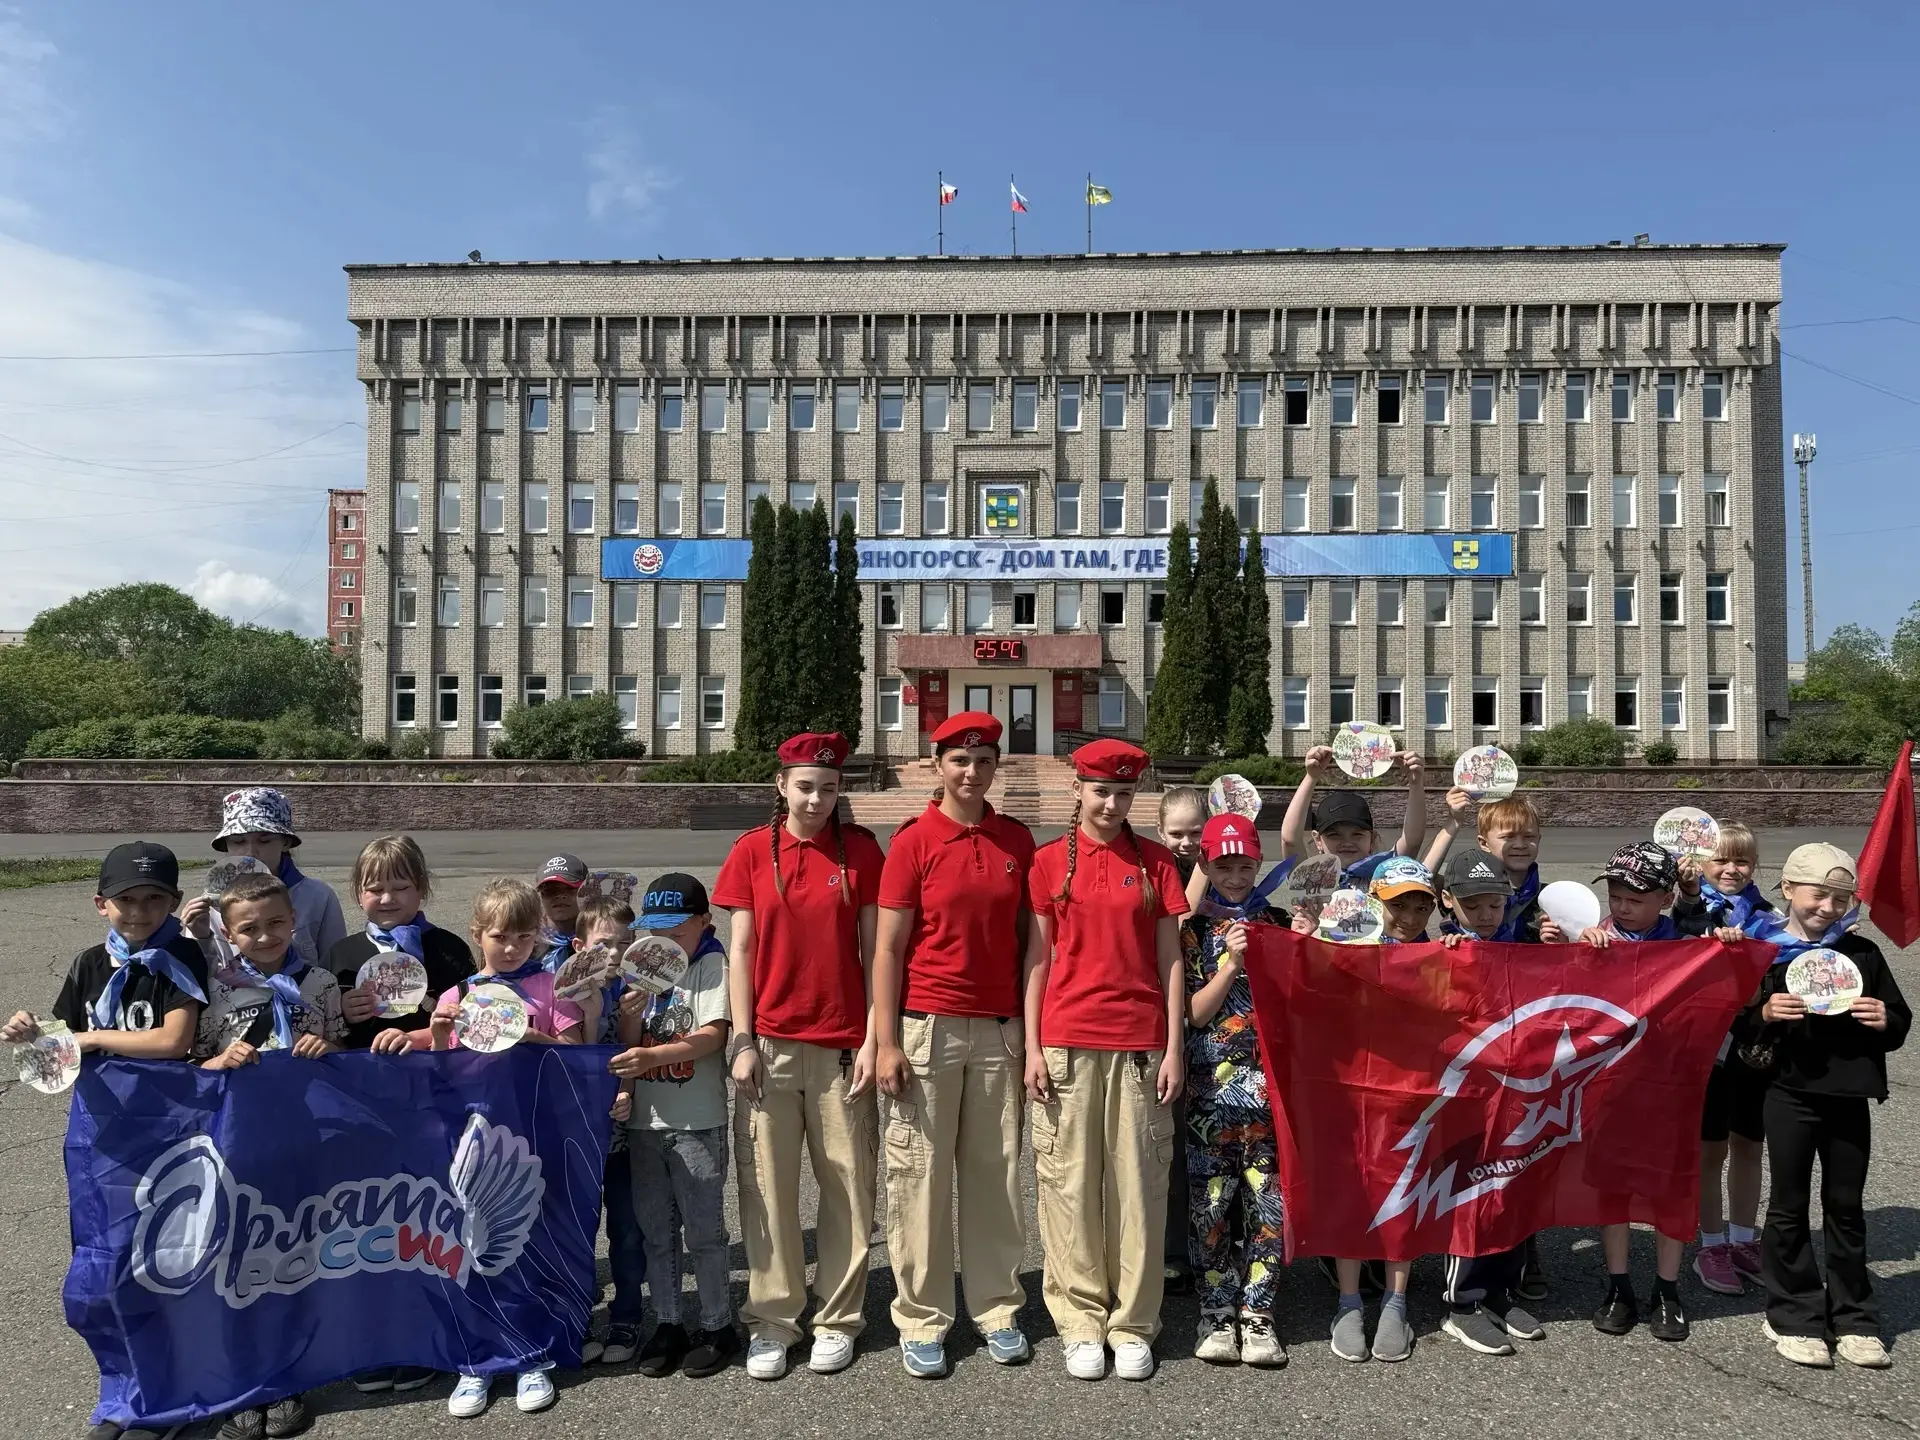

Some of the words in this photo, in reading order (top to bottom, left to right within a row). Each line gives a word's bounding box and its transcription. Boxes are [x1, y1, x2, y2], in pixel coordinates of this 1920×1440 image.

[861, 549, 981, 569] ЯНОГОРСК
[1000, 549, 1056, 573] ДОМ
[1061, 549, 1117, 571] ТАМ,
[1122, 549, 1167, 573] ГДЕ
[543, 866, 568, 875] TOYOTA
[1468, 870, 1495, 878] adidas
[241, 1007, 259, 1019] NO
[1467, 1139, 1548, 1182] ЮНАРМЯ
[143, 1142, 466, 1289] Орлята
